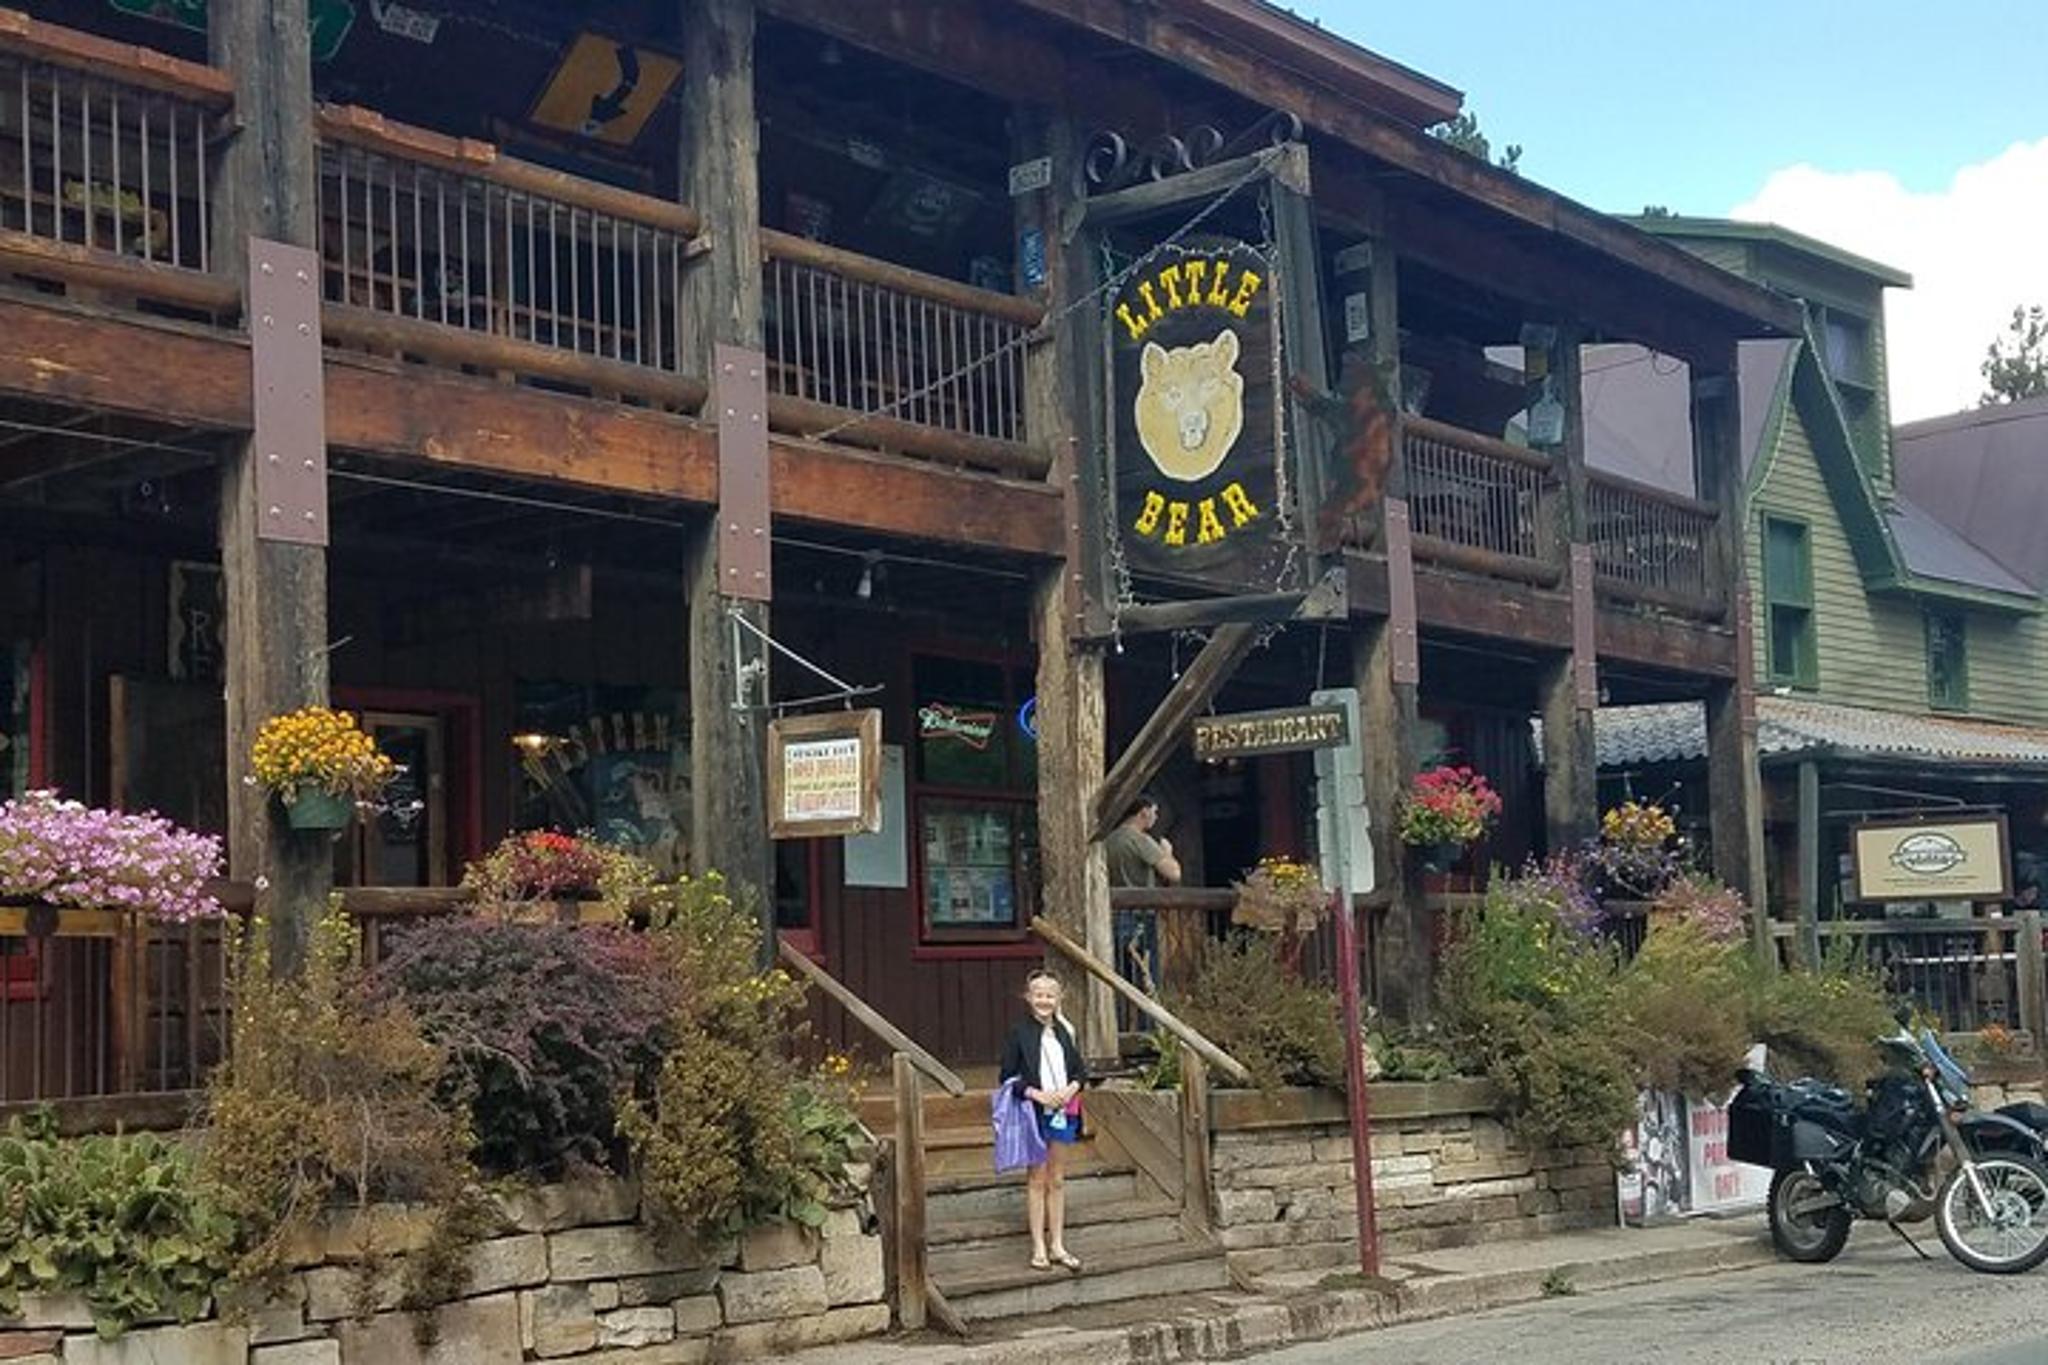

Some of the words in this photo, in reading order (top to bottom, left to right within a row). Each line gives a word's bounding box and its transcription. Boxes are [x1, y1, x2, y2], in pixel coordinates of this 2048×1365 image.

[1115, 260, 1261, 341] LITTLE
[1134, 482, 1259, 546] BEAR
[918, 707, 992, 738] Budweiser
[1196, 712, 1341, 751] RESTAURANT
